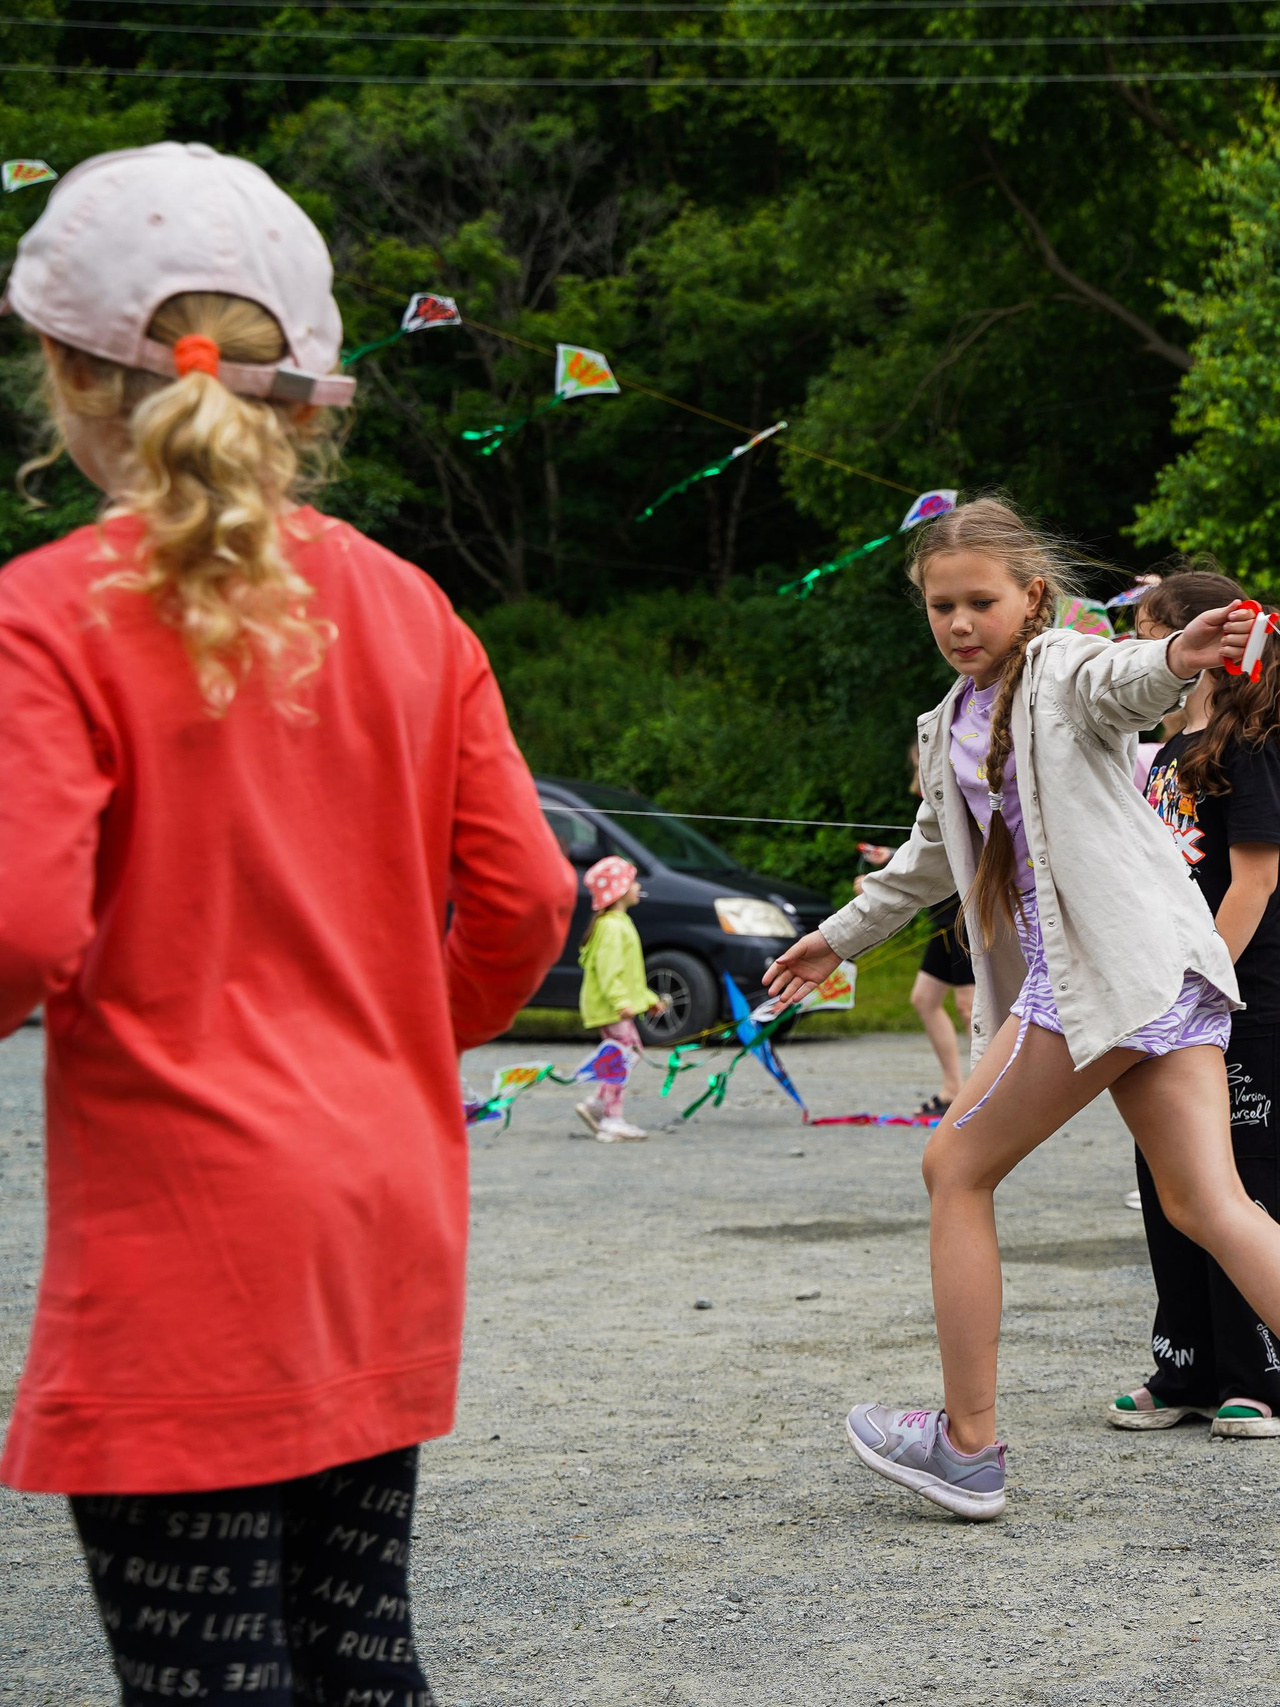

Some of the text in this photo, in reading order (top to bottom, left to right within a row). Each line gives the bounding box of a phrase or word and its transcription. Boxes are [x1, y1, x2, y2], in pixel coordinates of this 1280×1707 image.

[1235, 1086, 1266, 1105] Version
[1230, 1100, 1271, 1127] urself
[358, 1483, 412, 1520] LIFE
[325, 1523, 380, 1557] MY
[201, 1612, 267, 1642] LIFE
